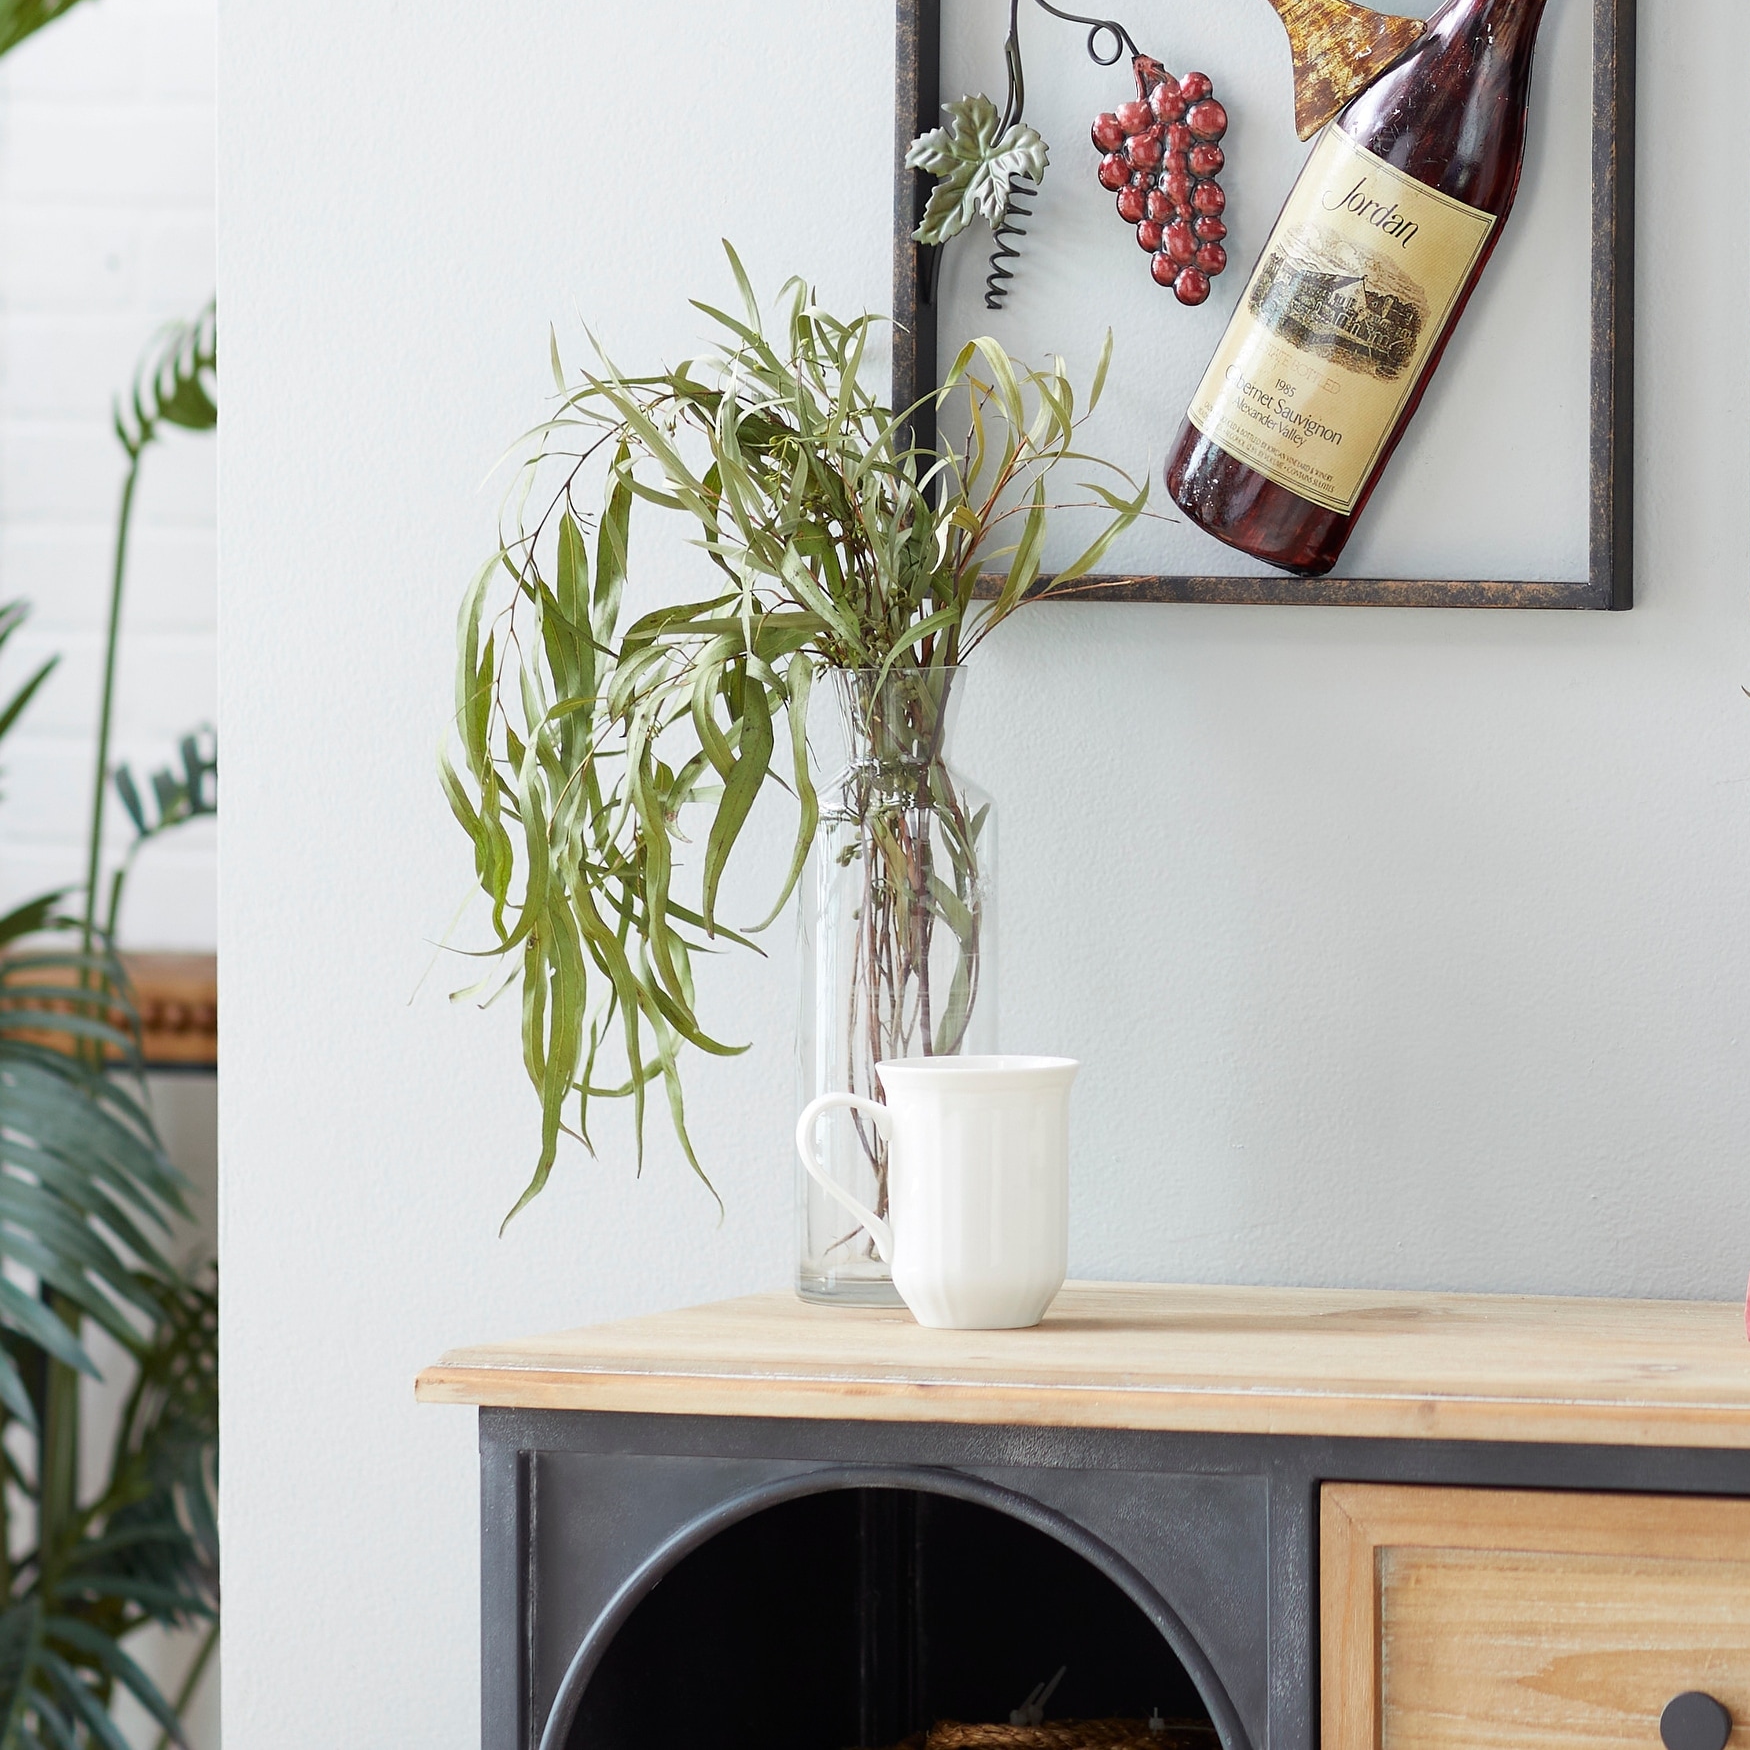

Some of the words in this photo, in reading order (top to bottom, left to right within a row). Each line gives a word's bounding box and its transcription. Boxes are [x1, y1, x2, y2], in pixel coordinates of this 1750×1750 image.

[1321, 177, 1420, 250] Jordan
[1273, 377, 1297, 399] 1985
[1231, 395, 1278, 430] Alexander
[1275, 421, 1307, 448] Valley
[1273, 397, 1343, 446] Sauvignon
